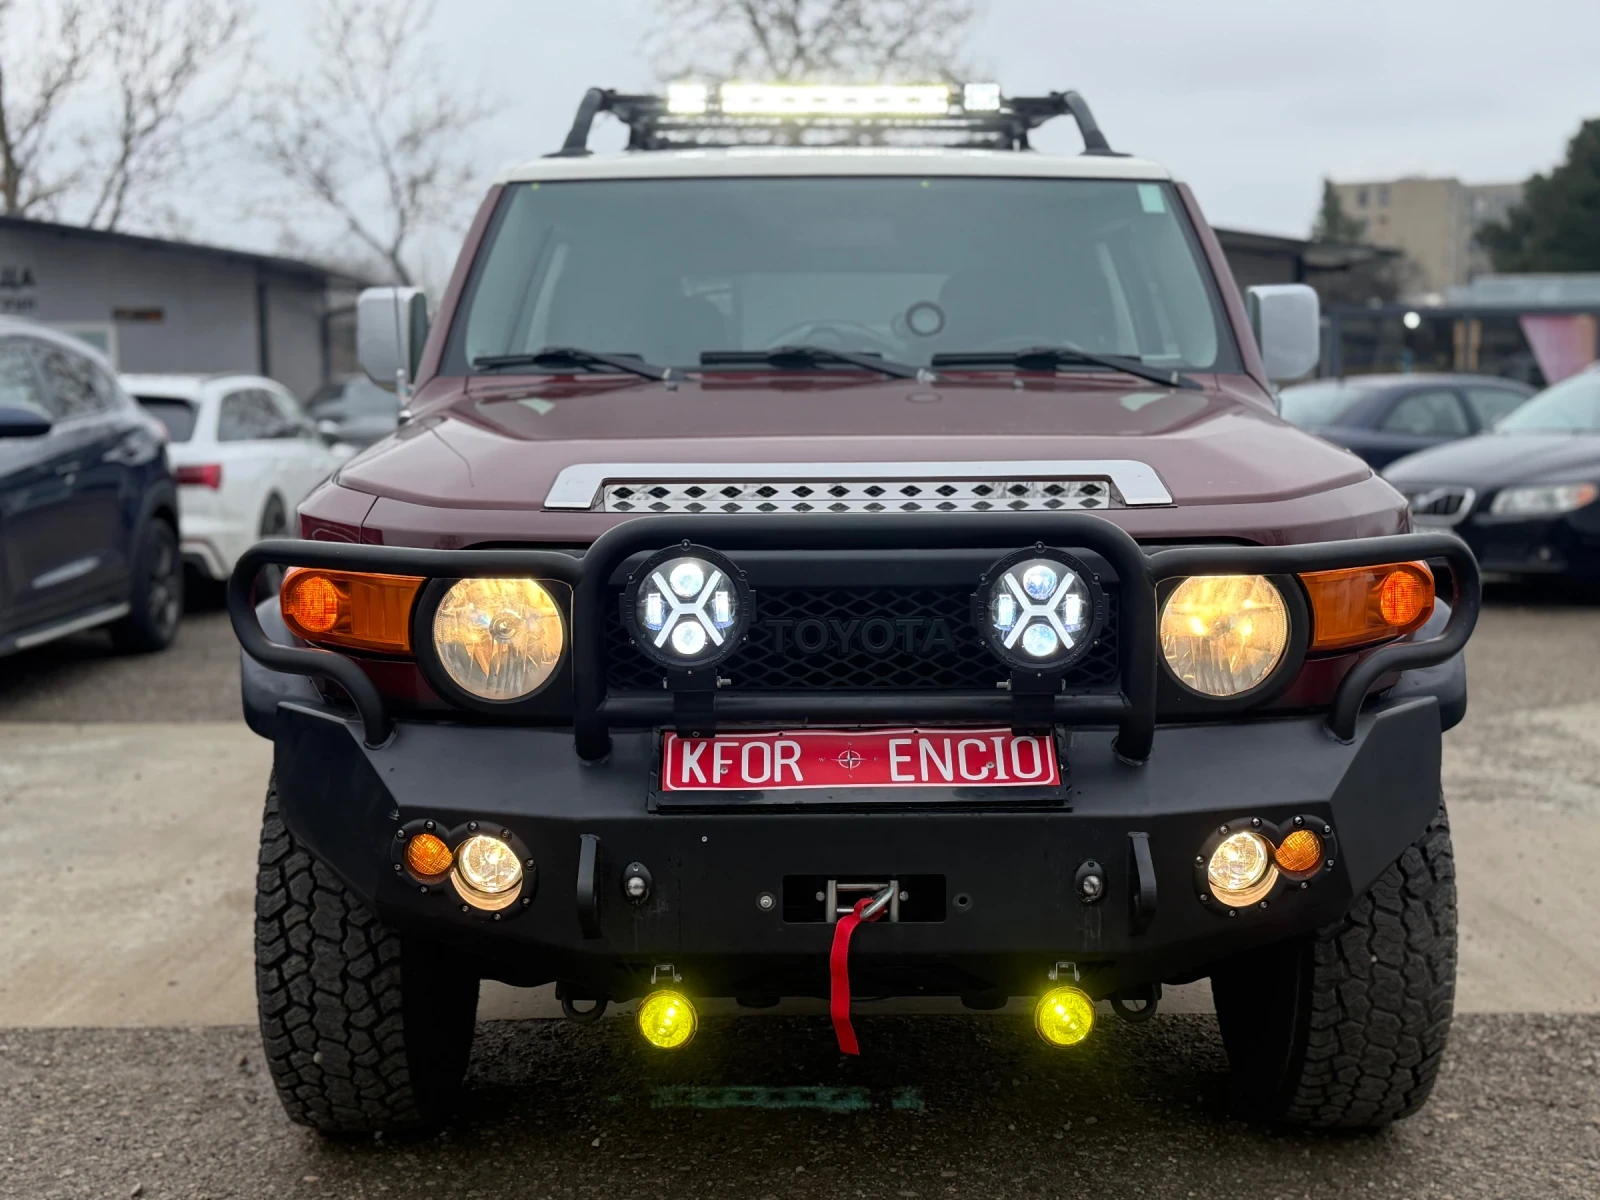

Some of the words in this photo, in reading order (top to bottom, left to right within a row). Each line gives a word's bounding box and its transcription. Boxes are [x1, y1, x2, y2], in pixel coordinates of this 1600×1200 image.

[763, 617, 957, 654] TOYOTA
[681, 739, 804, 784] KFOR
[888, 736, 1043, 782] ENCIO
